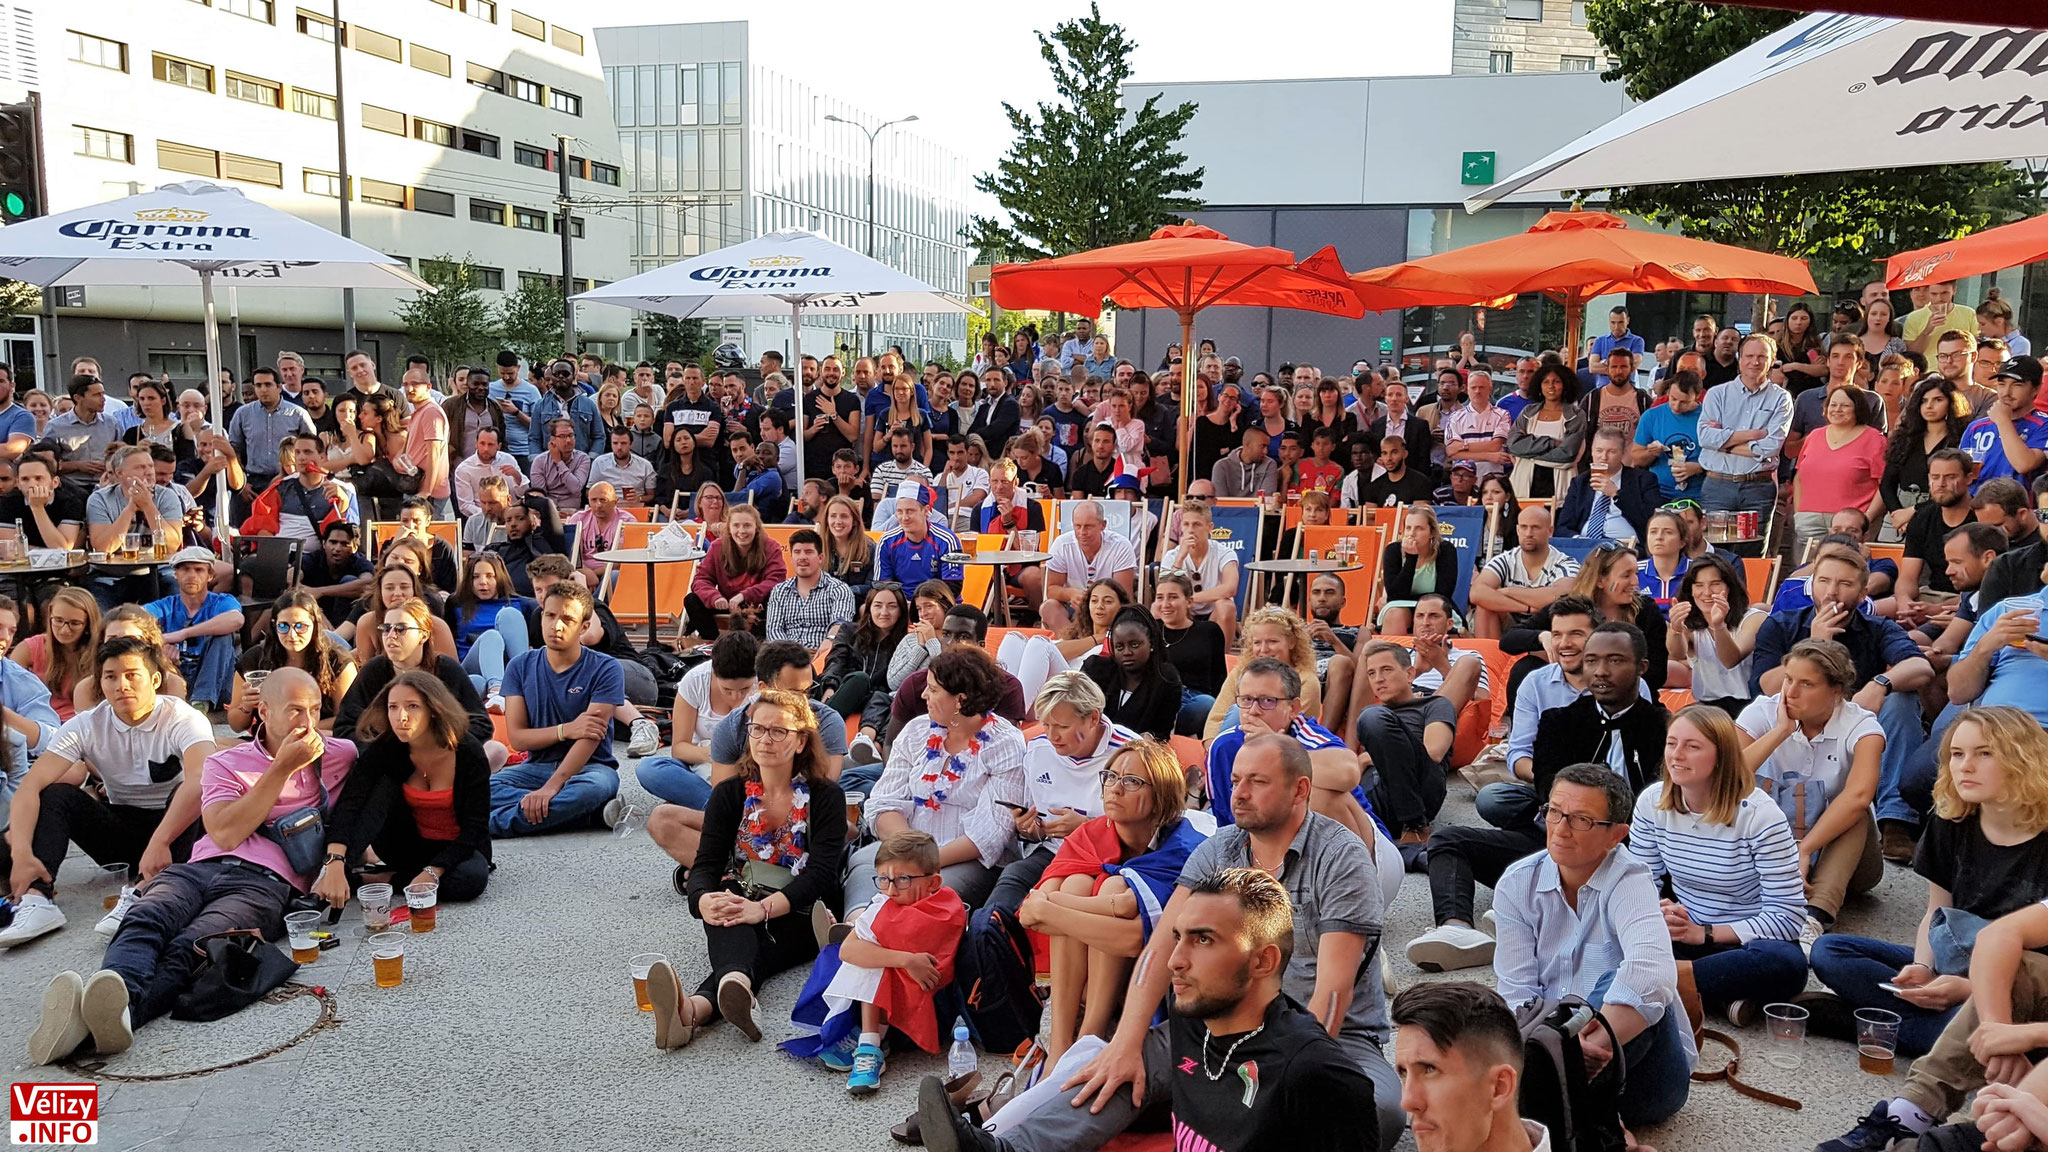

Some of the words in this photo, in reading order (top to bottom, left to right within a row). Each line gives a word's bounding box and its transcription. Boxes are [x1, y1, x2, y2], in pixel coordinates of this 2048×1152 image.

[58, 219, 253, 241] Corona
[108, 237, 213, 251] Extra
[689, 266, 832, 283] Corona
[718, 280, 796, 289] Extra
[696, 412, 706, 420] 10
[1973, 431, 1995, 452] 10
